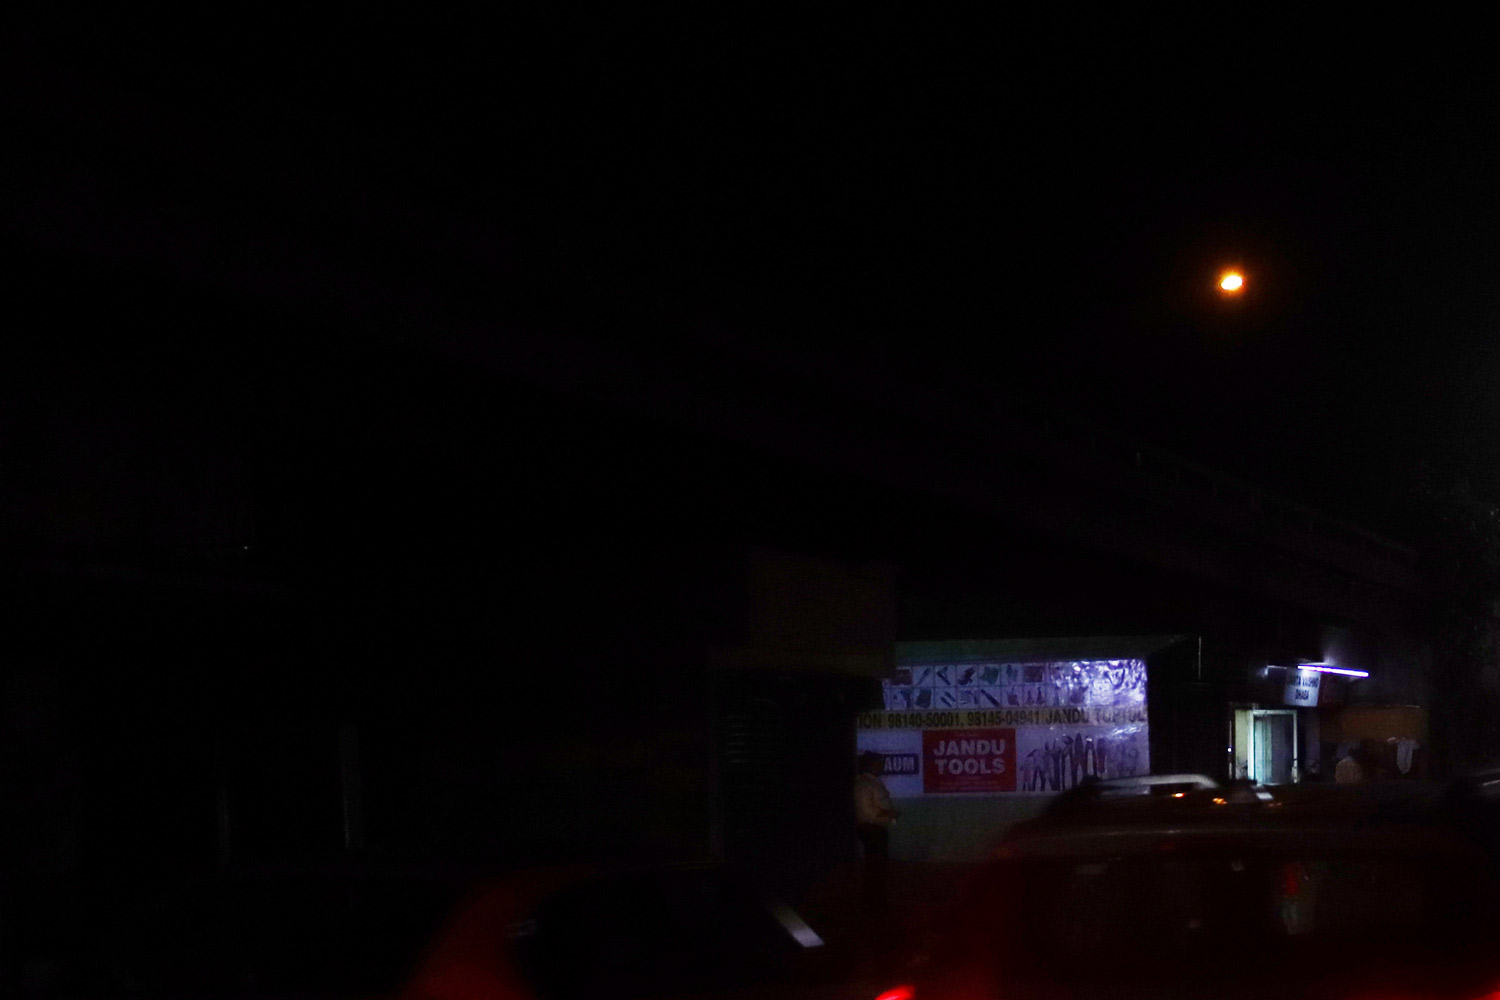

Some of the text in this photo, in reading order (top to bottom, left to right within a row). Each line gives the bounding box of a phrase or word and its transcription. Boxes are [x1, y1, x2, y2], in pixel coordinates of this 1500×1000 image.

[1045, 706, 1090, 724] JANDU
[933, 738, 1006, 756] JANDU
[934, 757, 1007, 775] TOOLS
